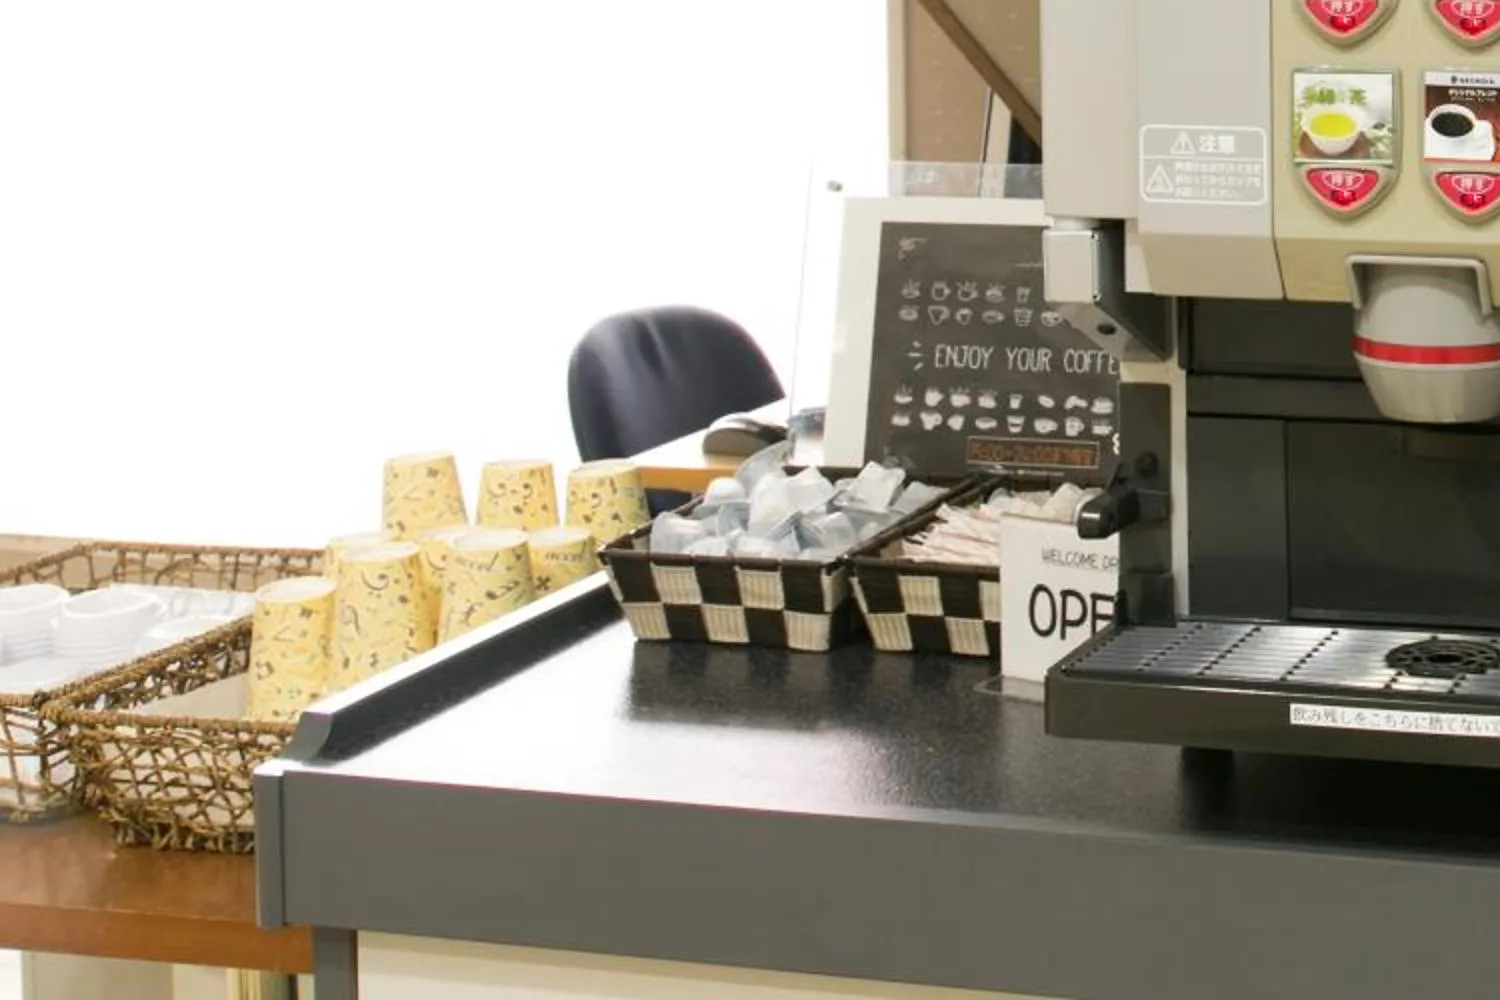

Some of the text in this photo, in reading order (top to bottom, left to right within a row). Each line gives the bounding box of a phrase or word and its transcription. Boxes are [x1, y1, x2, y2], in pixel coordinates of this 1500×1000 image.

[934, 344, 995, 370] ENJOY
[1006, 346, 1052, 372] YOUR
[1041, 548, 1098, 570] WELCOME
